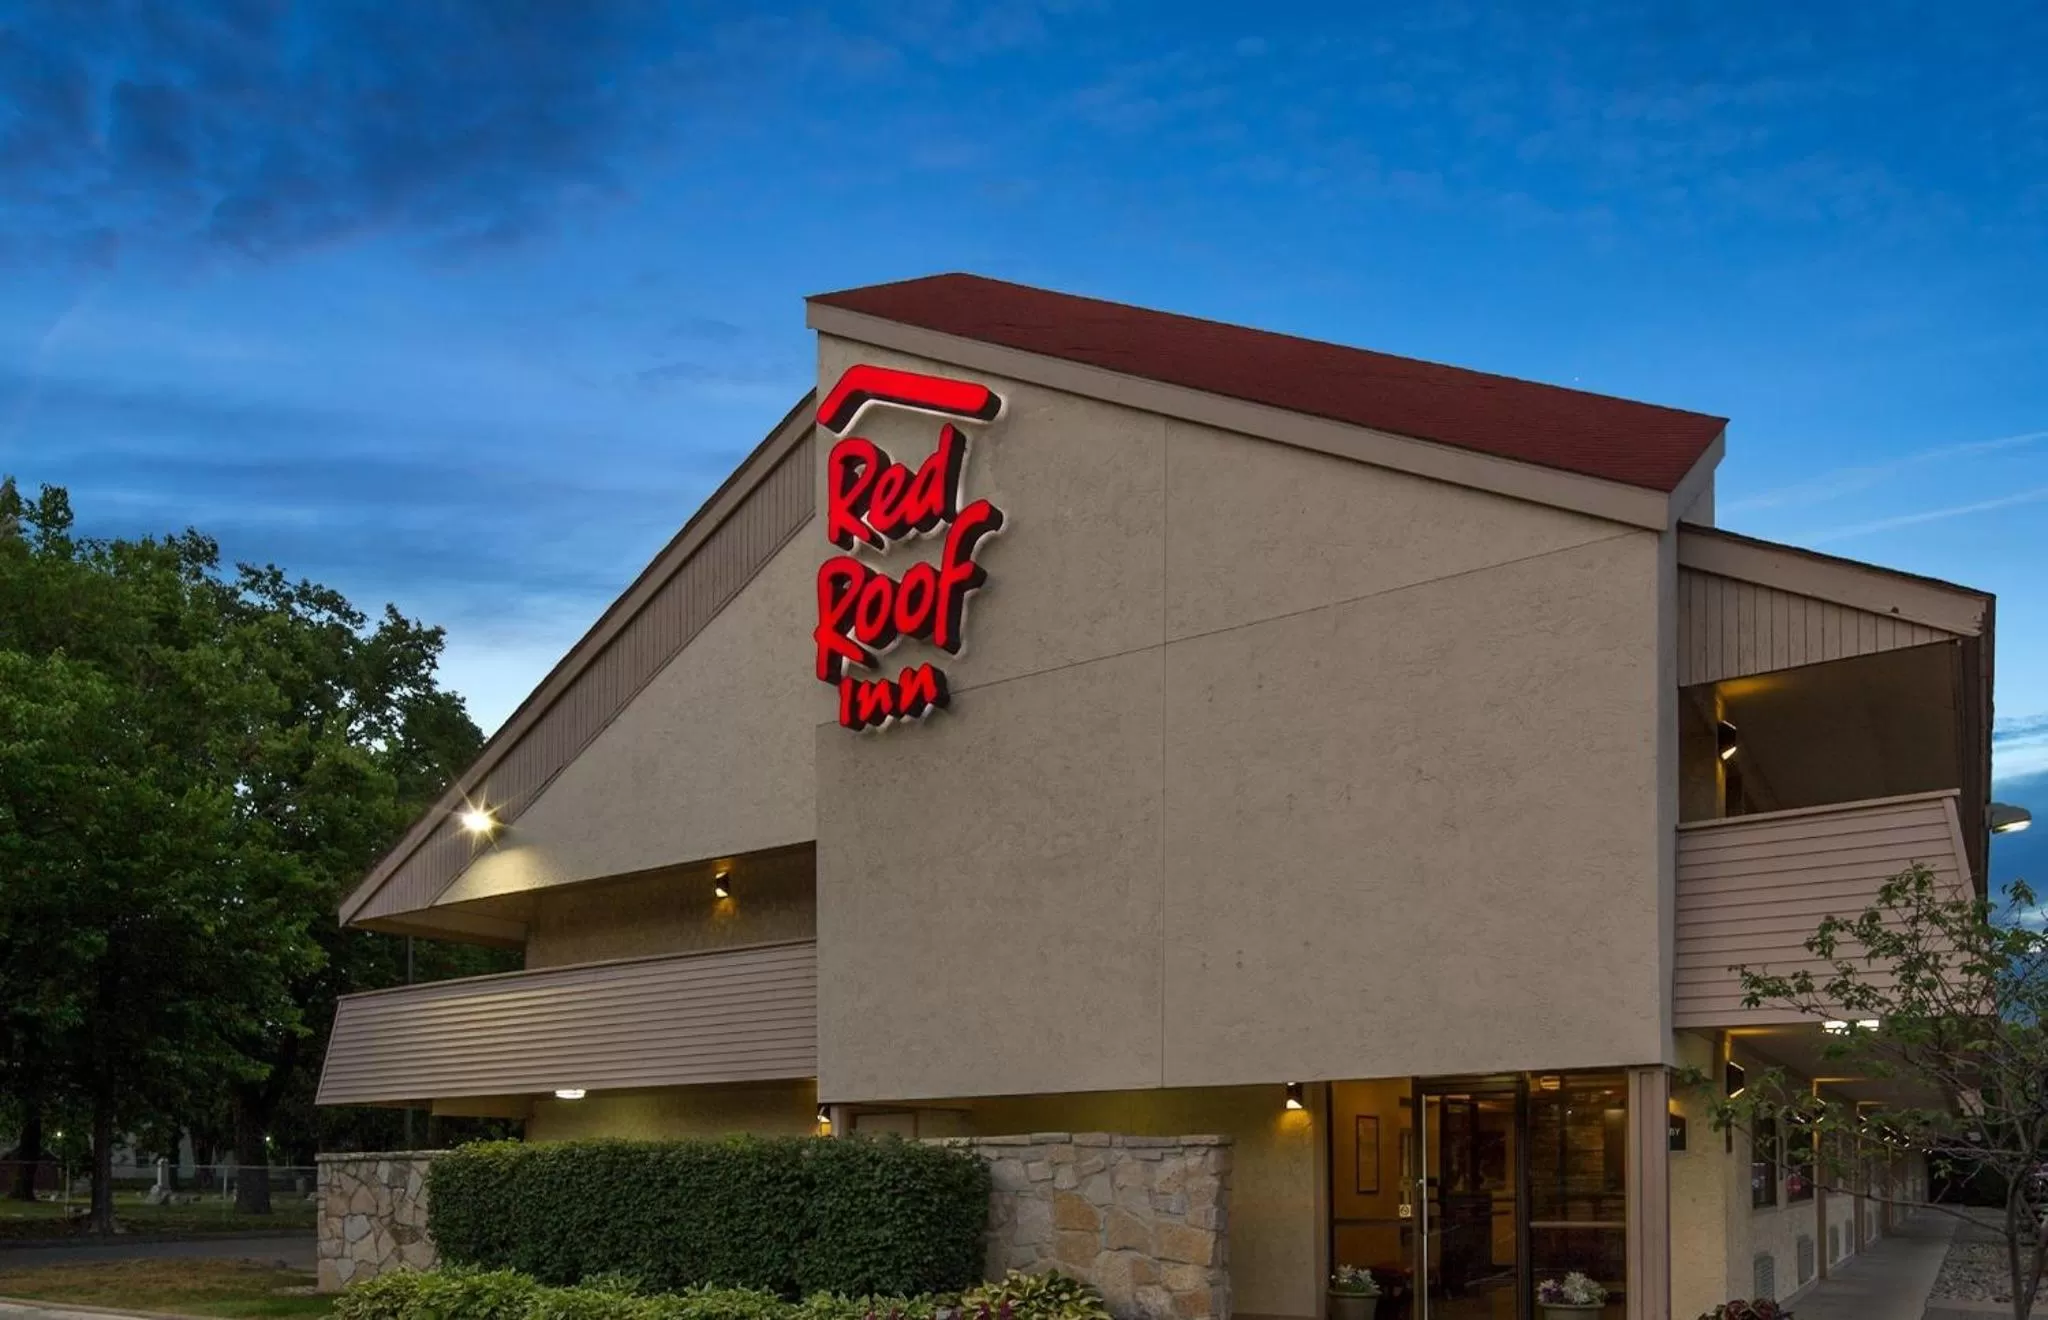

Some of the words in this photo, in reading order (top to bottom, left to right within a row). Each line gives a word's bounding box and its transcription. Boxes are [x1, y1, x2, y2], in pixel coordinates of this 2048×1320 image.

[827, 422, 956, 545] Red
[814, 499, 992, 682] Roof
[838, 662, 940, 729] Inn
